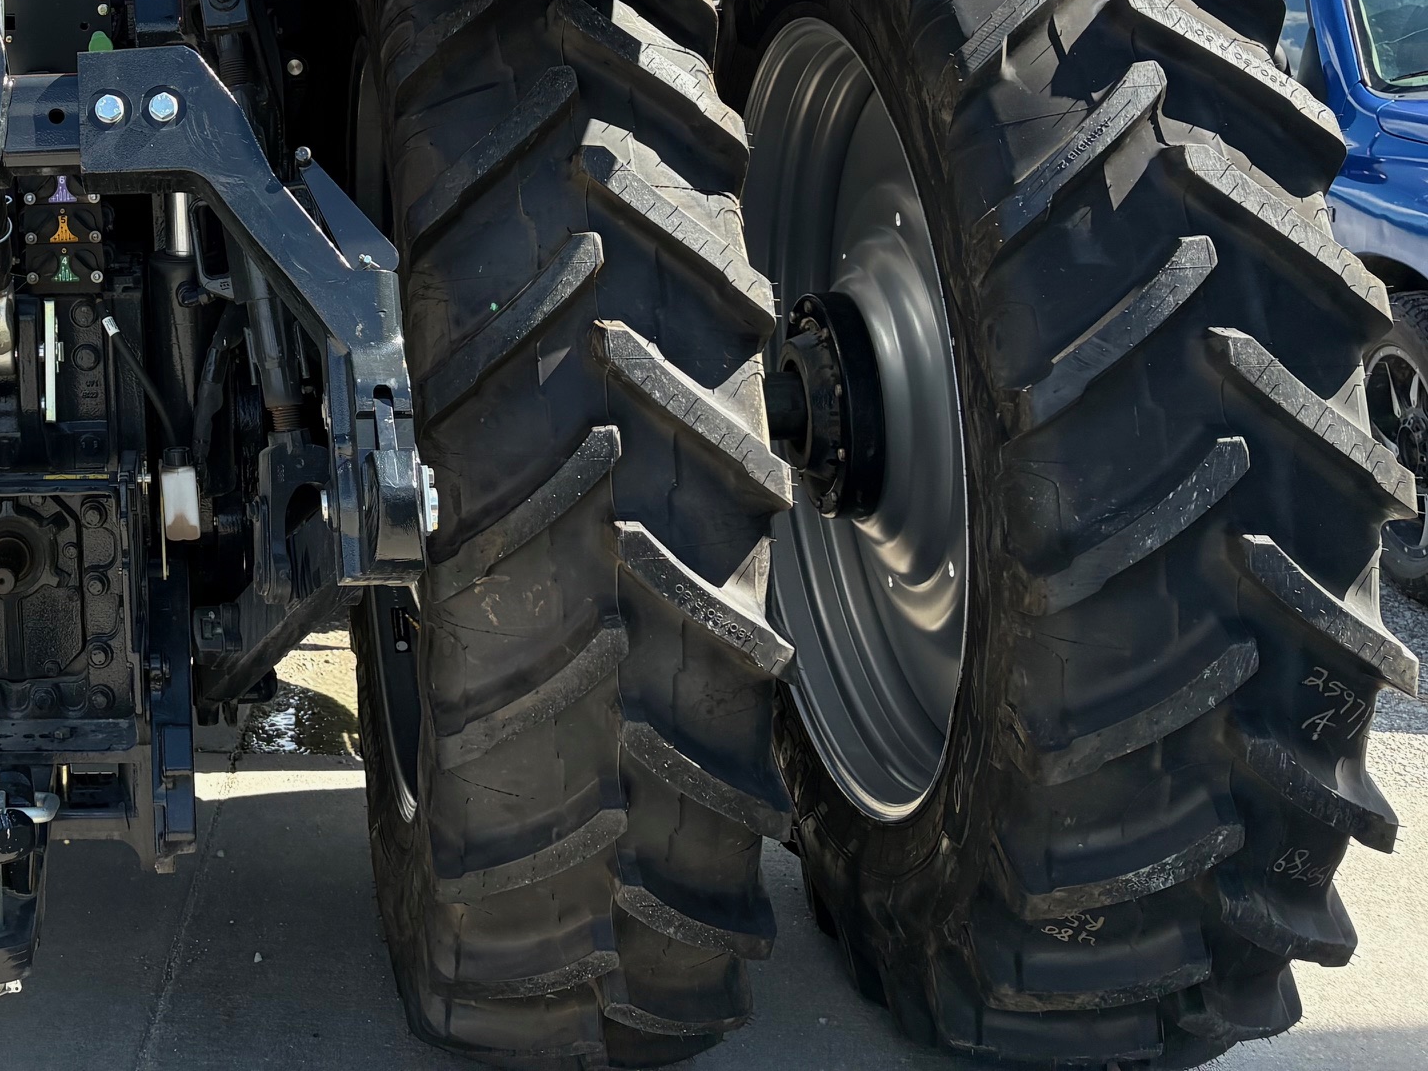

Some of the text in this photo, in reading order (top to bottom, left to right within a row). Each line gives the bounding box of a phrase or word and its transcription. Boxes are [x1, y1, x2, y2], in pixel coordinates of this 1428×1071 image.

[59, 176, 65, 184] 6
[60, 216, 66, 224] 5
[61, 256, 68, 265] 4
